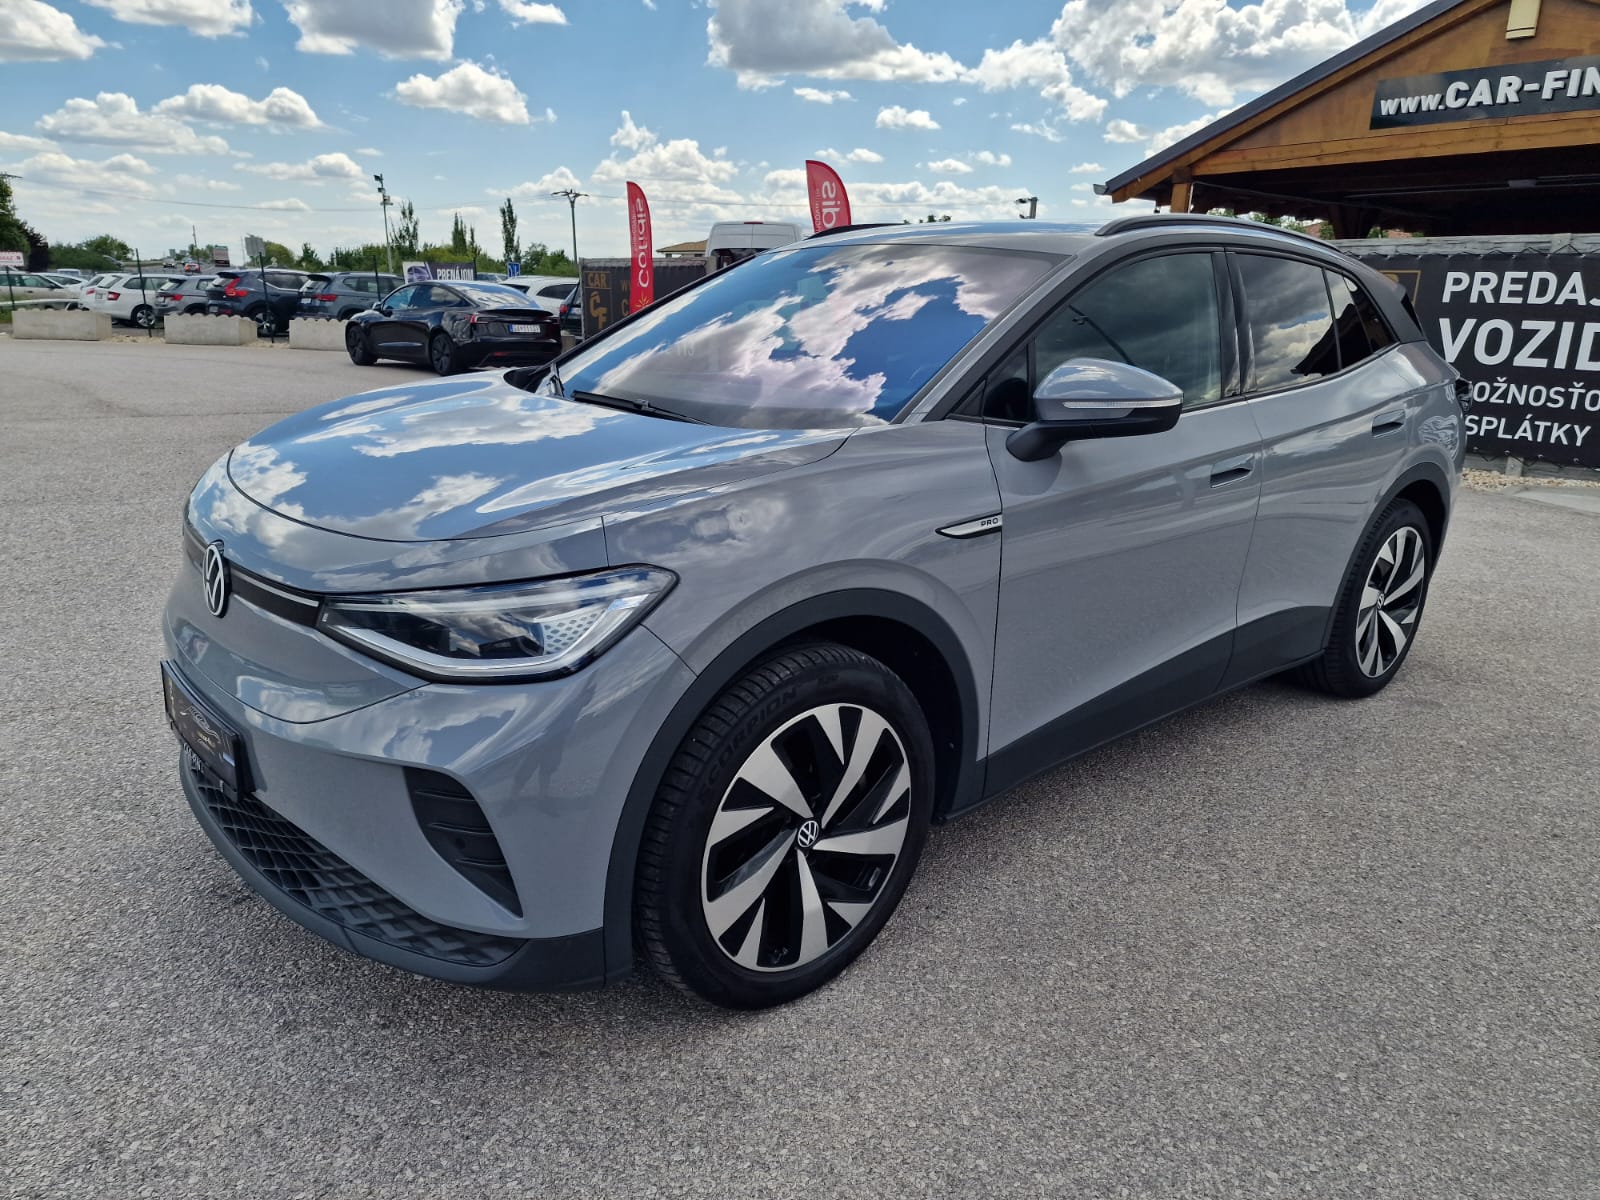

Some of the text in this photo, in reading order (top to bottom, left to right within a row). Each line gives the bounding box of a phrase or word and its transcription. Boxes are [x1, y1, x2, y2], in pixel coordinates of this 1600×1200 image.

[588, 272, 607, 289] CAR
[1472, 376, 1600, 412] OŽNOSŤO
[1465, 413, 1592, 447] SPLÁTKY
[980, 517, 999, 527] PRO
